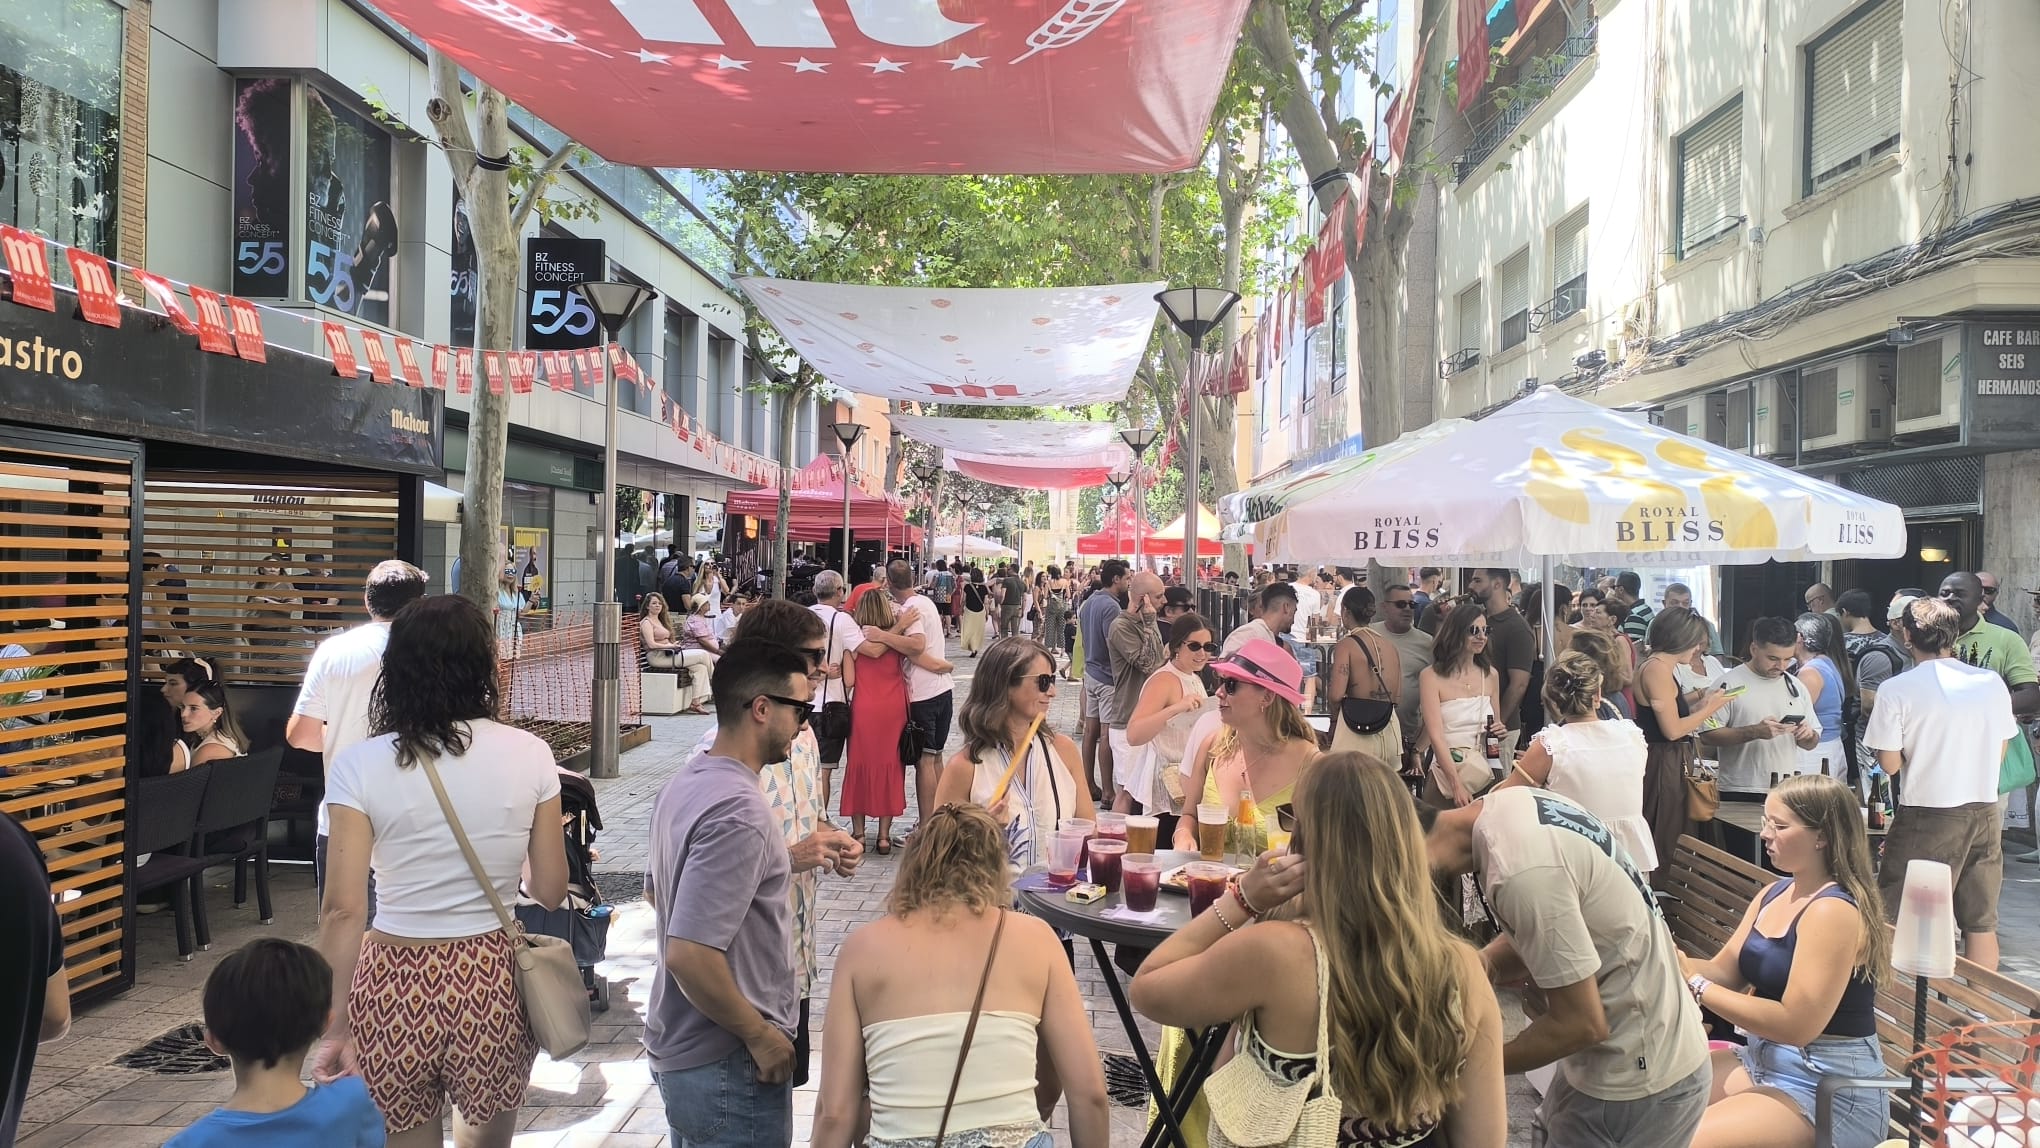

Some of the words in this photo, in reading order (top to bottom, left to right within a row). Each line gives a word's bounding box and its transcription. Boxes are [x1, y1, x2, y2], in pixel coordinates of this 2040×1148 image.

[309, 192, 321, 207] BZ
[239, 216, 251, 224] BZ
[309, 206, 342, 230] FITNESS
[239, 223, 271, 232] FITNESS
[238, 241, 285, 275] 55
[535, 252, 549, 262] BZ
[535, 262, 575, 272] FITNESS
[308, 240, 355, 312] 55
[535, 272, 584, 282] CONCEPT
[531, 290, 596, 336] 55
[1984, 330, 2012, 346] CAFE
[2016, 330, 2040, 346] BAR
[0, 336, 83, 380] astro
[1999, 353, 2025, 369] SEIS
[1977, 379, 2040, 396] HERMANOS
[391, 408, 429, 435] Mahou
[1640, 507, 1699, 518] ROYAL
[1846, 510, 1867, 522] ROYAL
[1374, 516, 1421, 528] ROYAL
[1615, 520, 1725, 542] BLISS
[1353, 528, 1439, 551] BLISS
